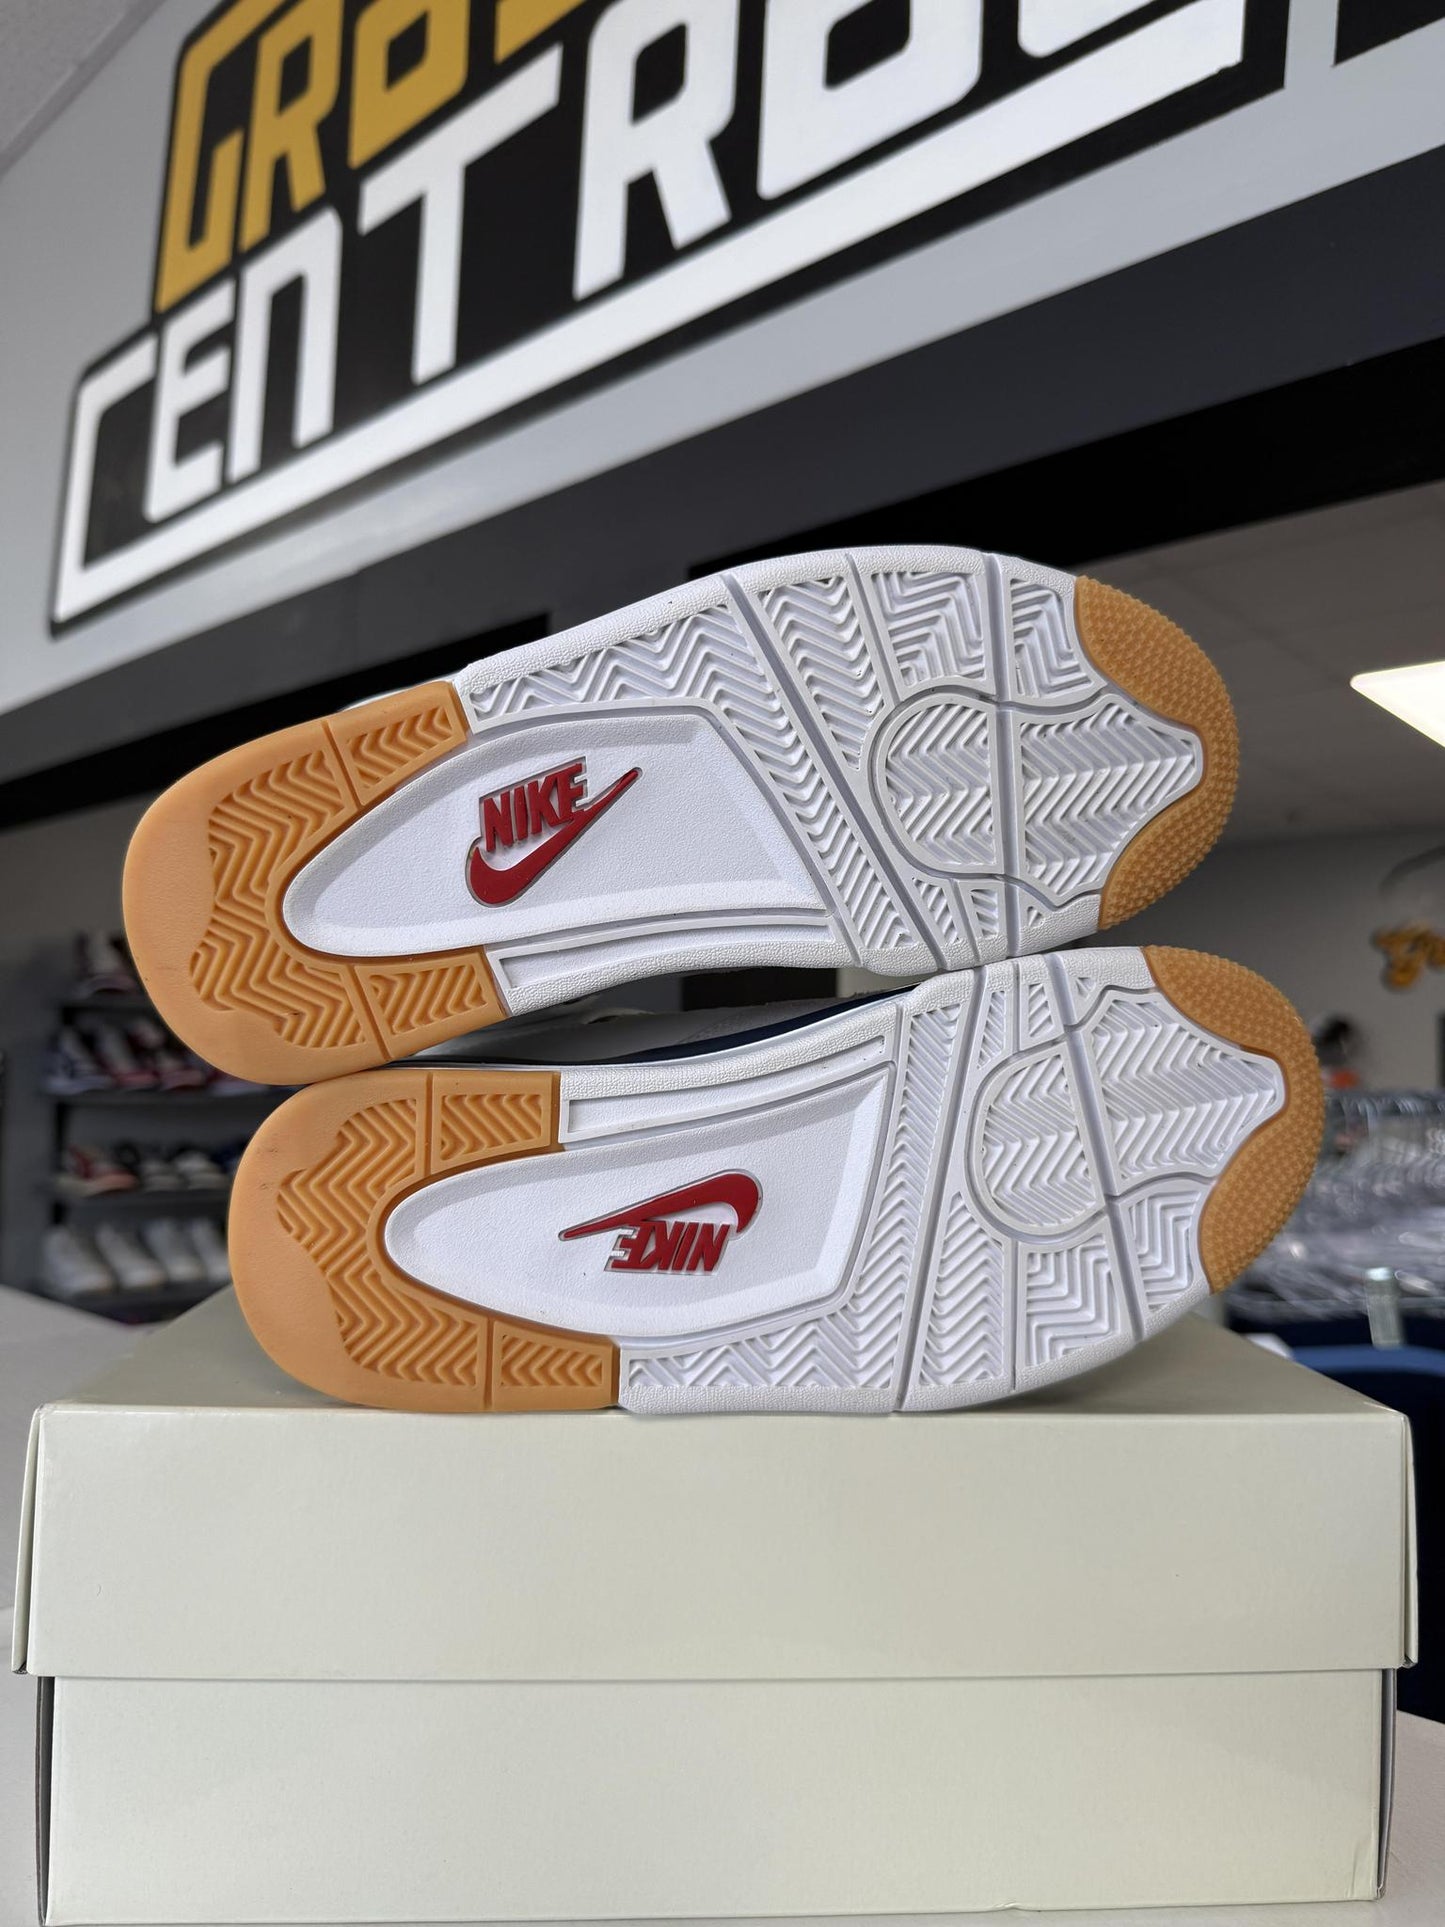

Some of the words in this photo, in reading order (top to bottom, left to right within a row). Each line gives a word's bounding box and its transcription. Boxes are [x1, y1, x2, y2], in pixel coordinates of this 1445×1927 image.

[155, 0, 594, 312] GRO
[54, 0, 1242, 623] CENTRO
[483, 763, 584, 853] NIKE
[610, 1220, 731, 1272] NIKE
